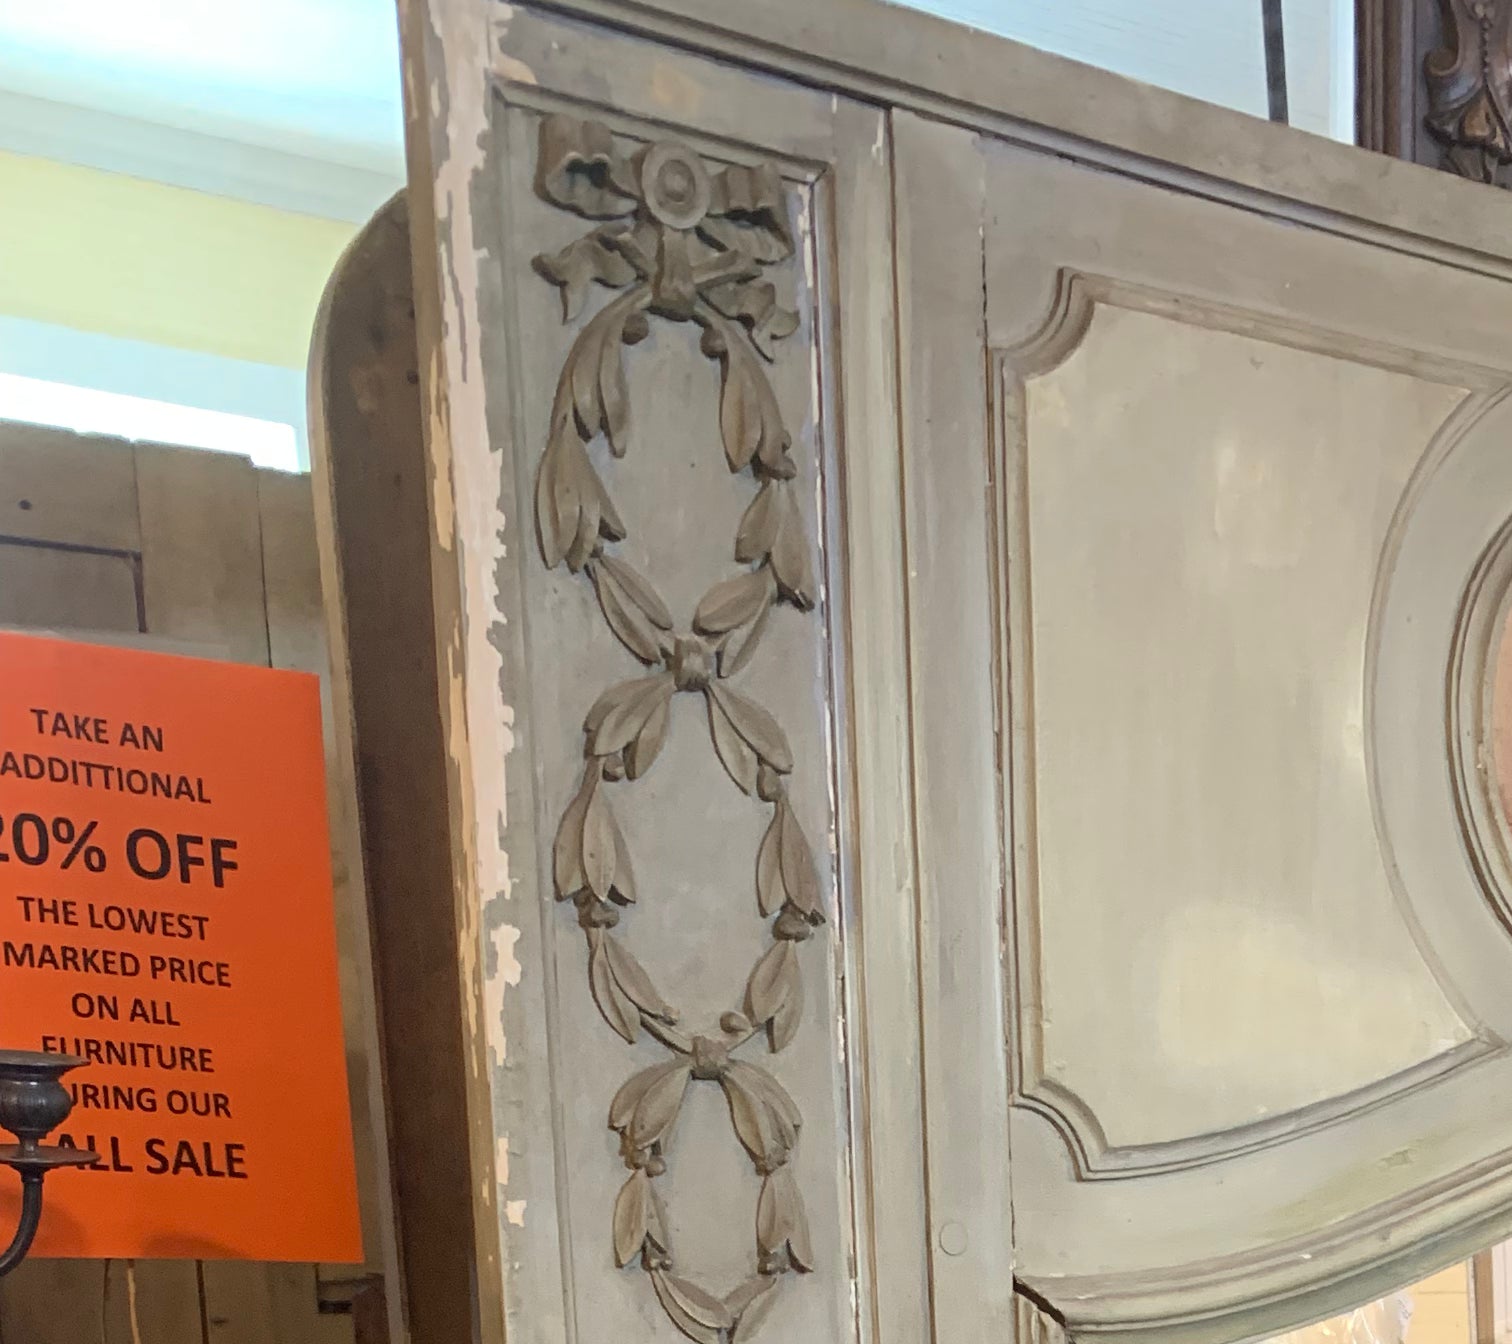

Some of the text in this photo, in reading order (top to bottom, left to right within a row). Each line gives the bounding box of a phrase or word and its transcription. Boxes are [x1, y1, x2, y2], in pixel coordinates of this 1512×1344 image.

[30, 708, 164, 752] TAKE AN
[0, 751, 212, 804] ADDITTIONAL
[126, 828, 239, 888] OFF
[17, 895, 210, 941] THE LOWEST
[3, 941, 232, 988] MARKED PRICE
[71, 992, 181, 1026] ON ALL
[72, 1083, 233, 1119] RING OUR
[58, 1133, 249, 1179] ALL SALE
